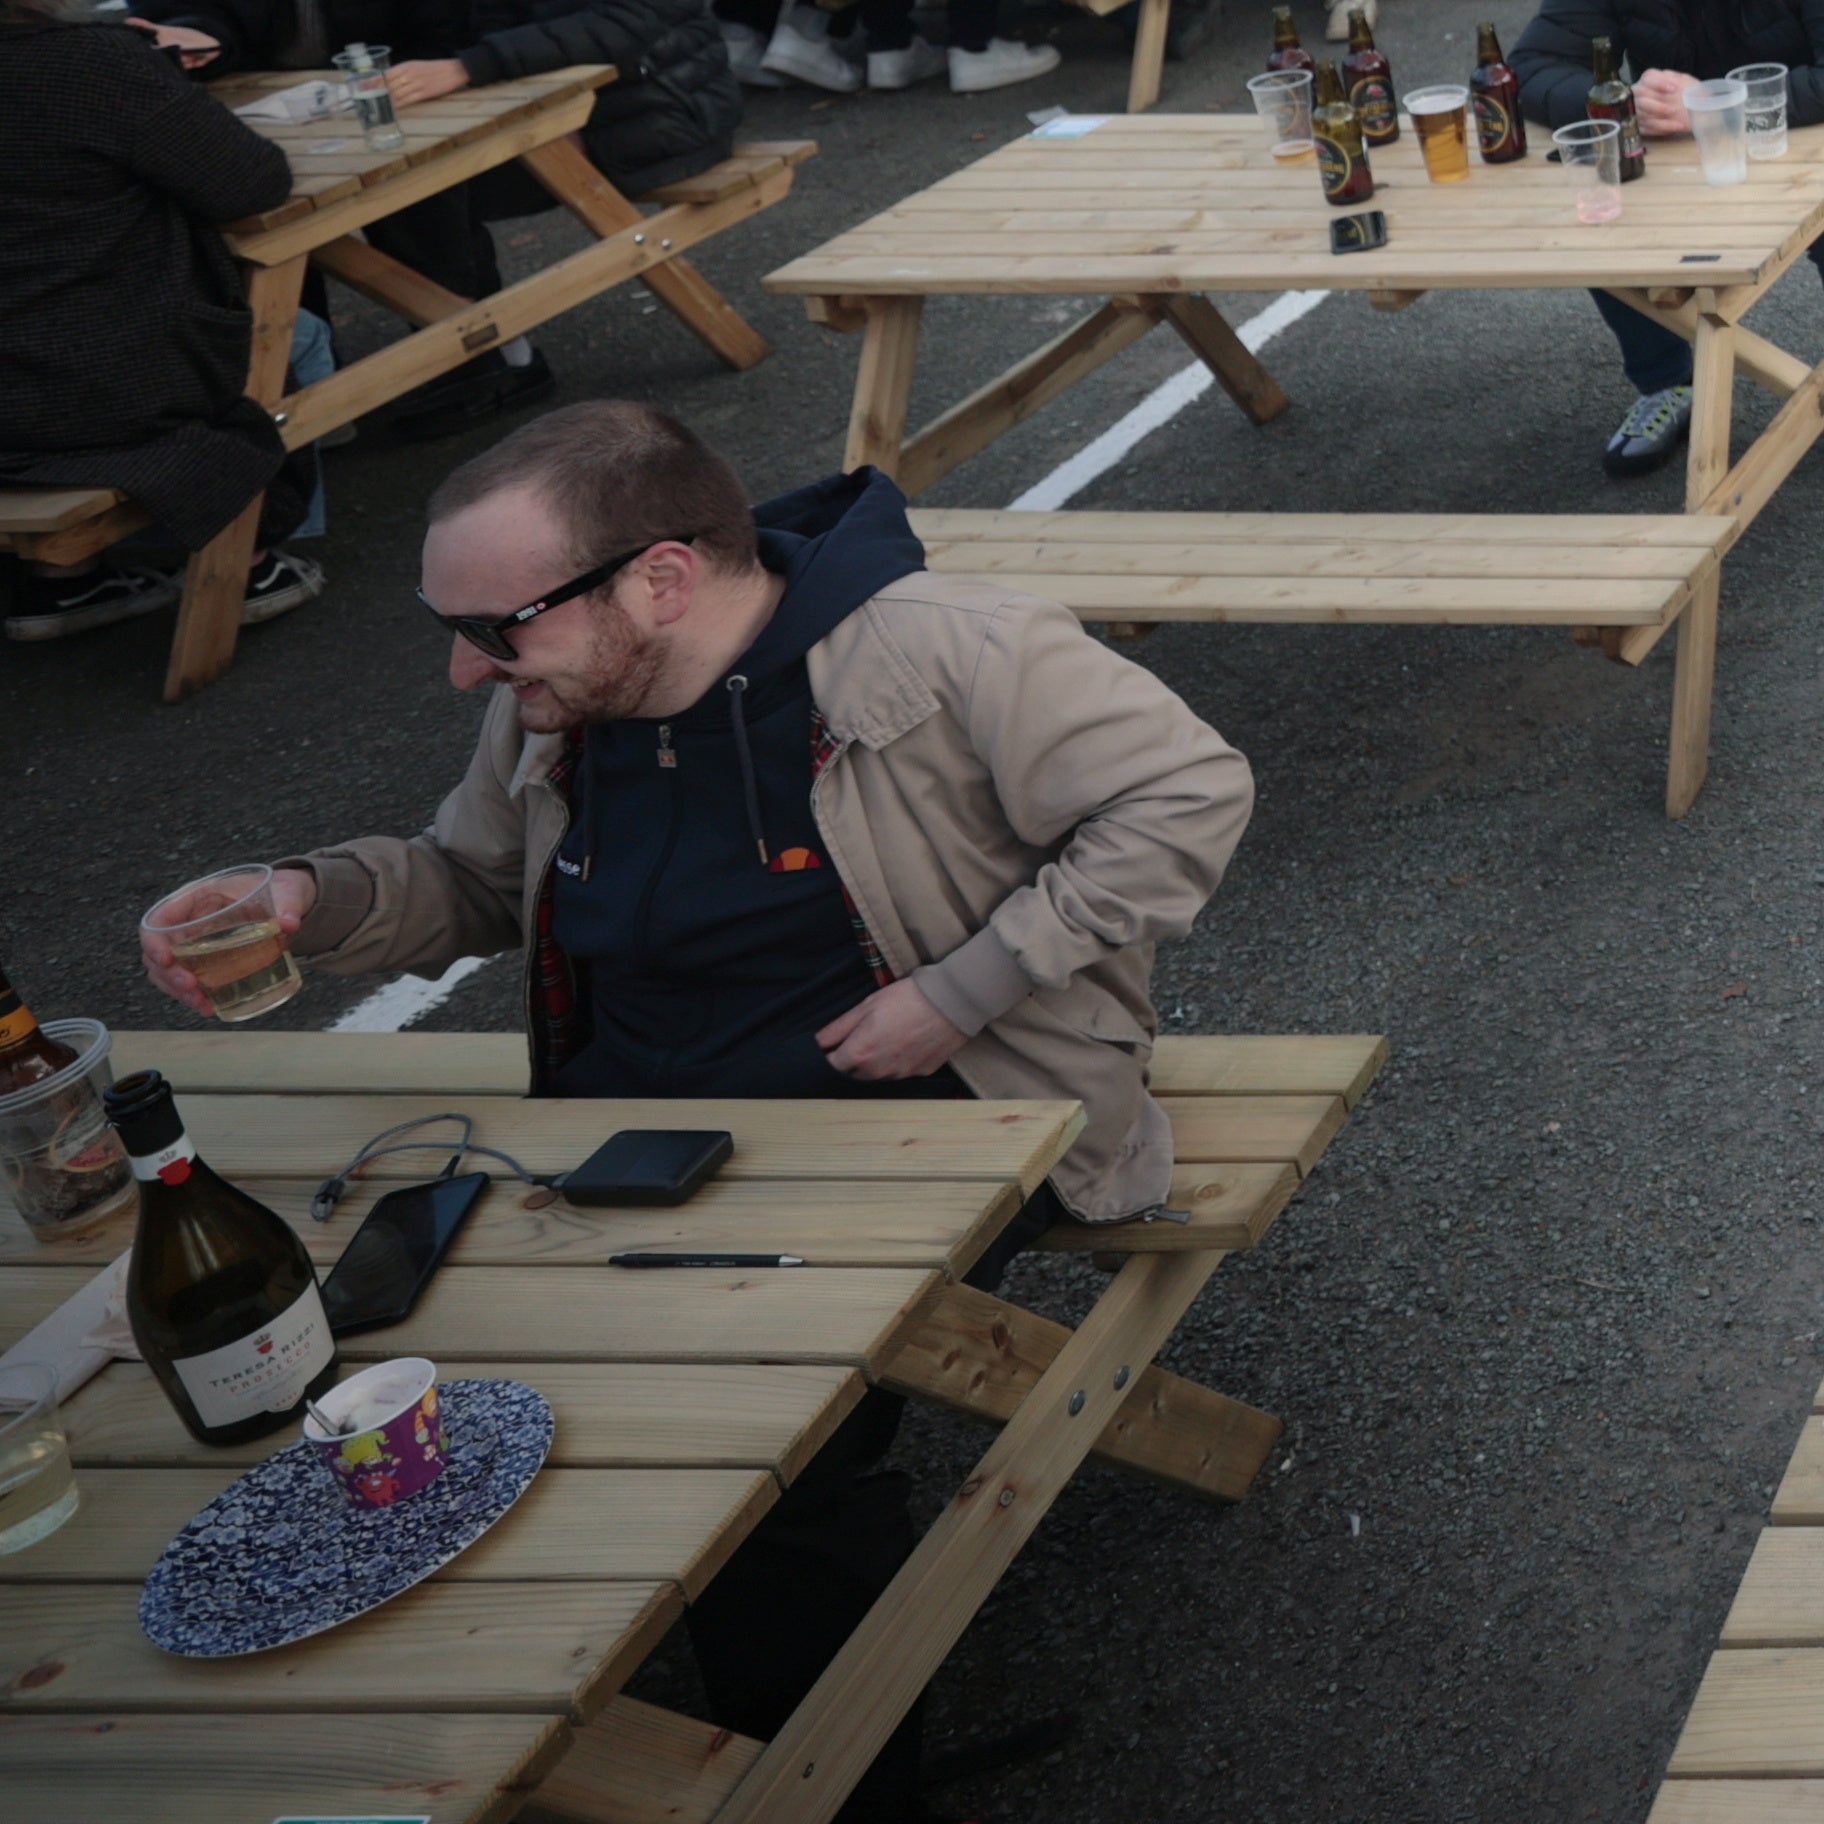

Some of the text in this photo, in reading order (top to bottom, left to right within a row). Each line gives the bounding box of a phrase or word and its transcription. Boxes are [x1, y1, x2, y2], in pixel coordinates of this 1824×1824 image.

[207, 1355, 277, 1389] TERESA
[281, 1322, 317, 1355] RIZZI
[228, 1340, 313, 1394] PROSECCO
